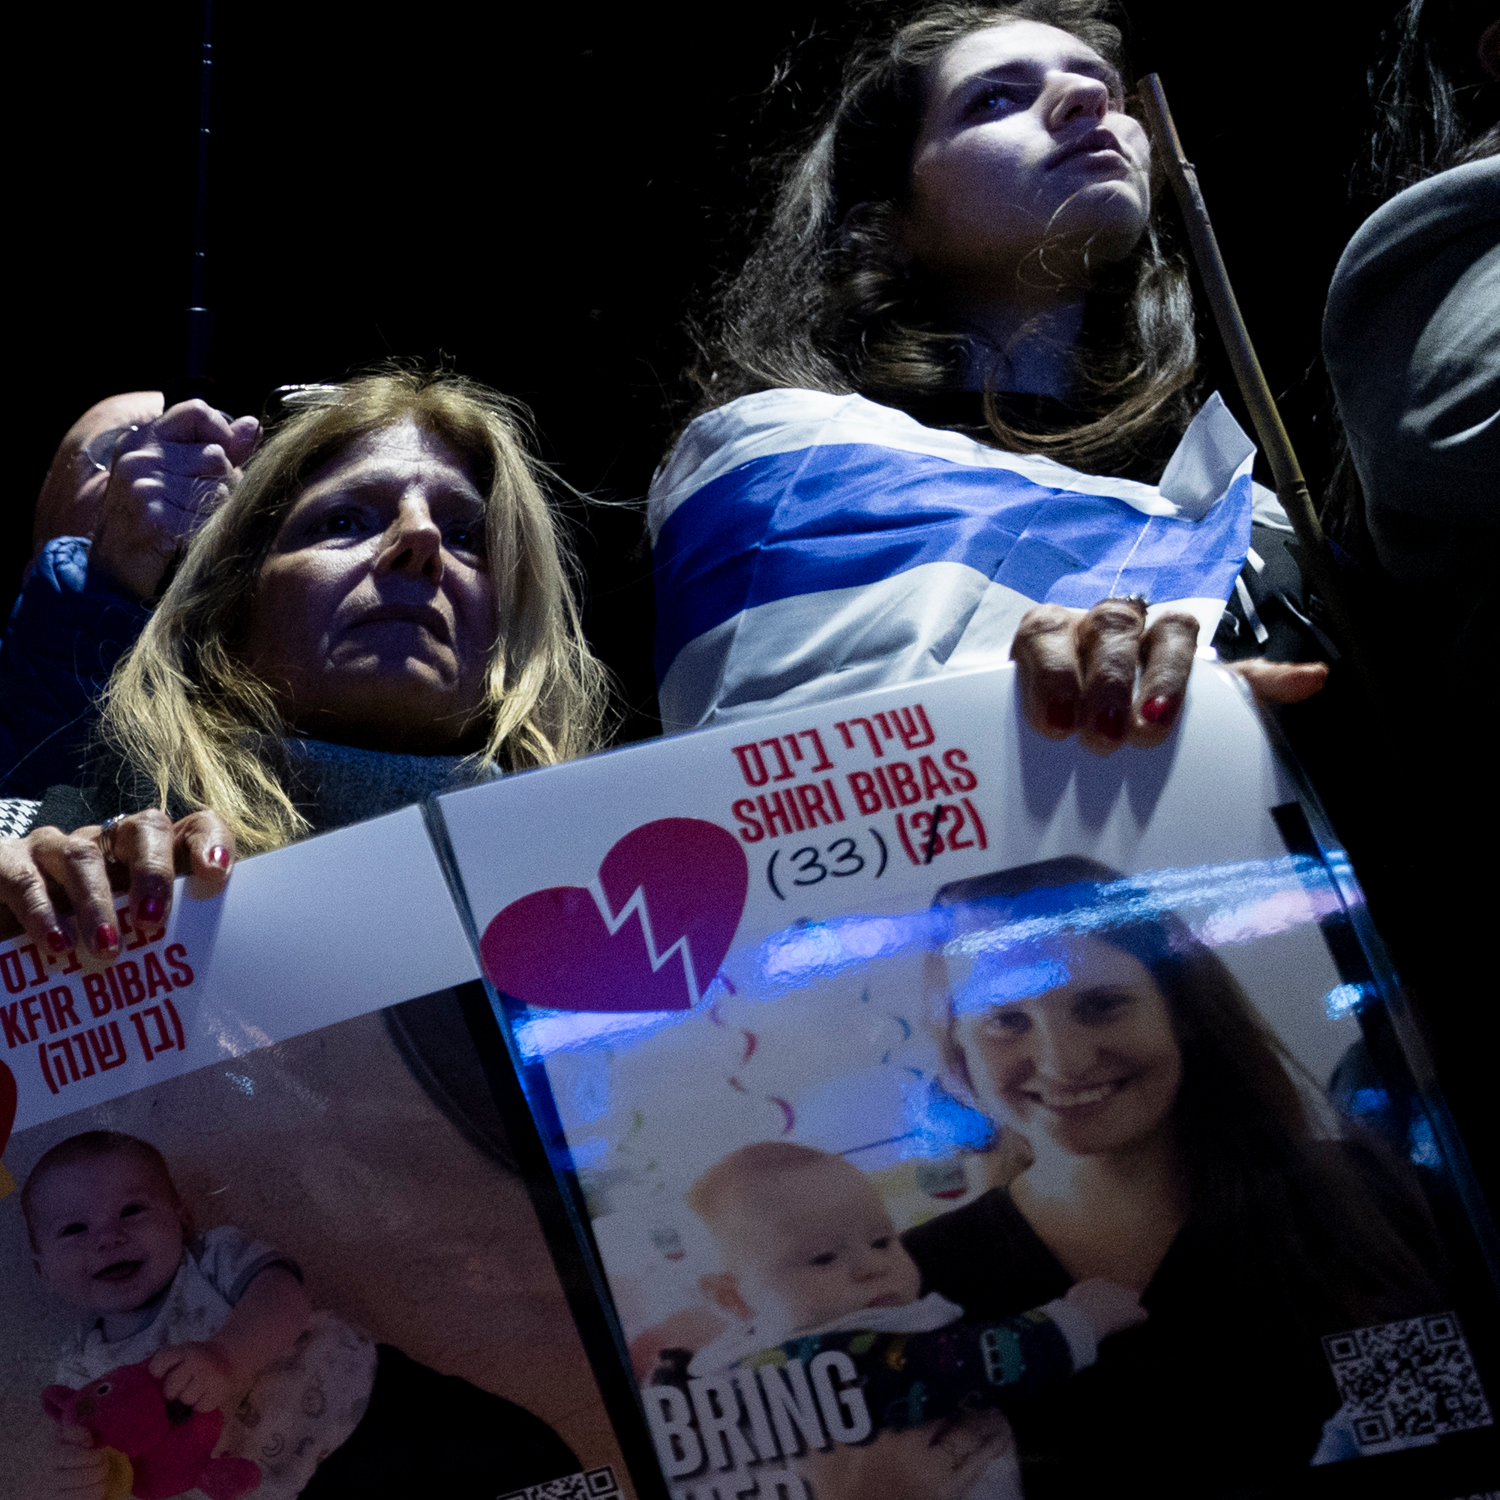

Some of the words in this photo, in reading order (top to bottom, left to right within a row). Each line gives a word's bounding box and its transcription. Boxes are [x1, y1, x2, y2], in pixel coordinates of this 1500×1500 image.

[731, 728, 834, 787] ביבס
[834, 703, 938, 760] שירי
[730, 780, 847, 846] SHIRI
[847, 748, 979, 817] BIBAS
[766, 828, 889, 901] (33)
[81, 943, 195, 1019] BIBAS
[642, 1350, 874, 1480] BRING
